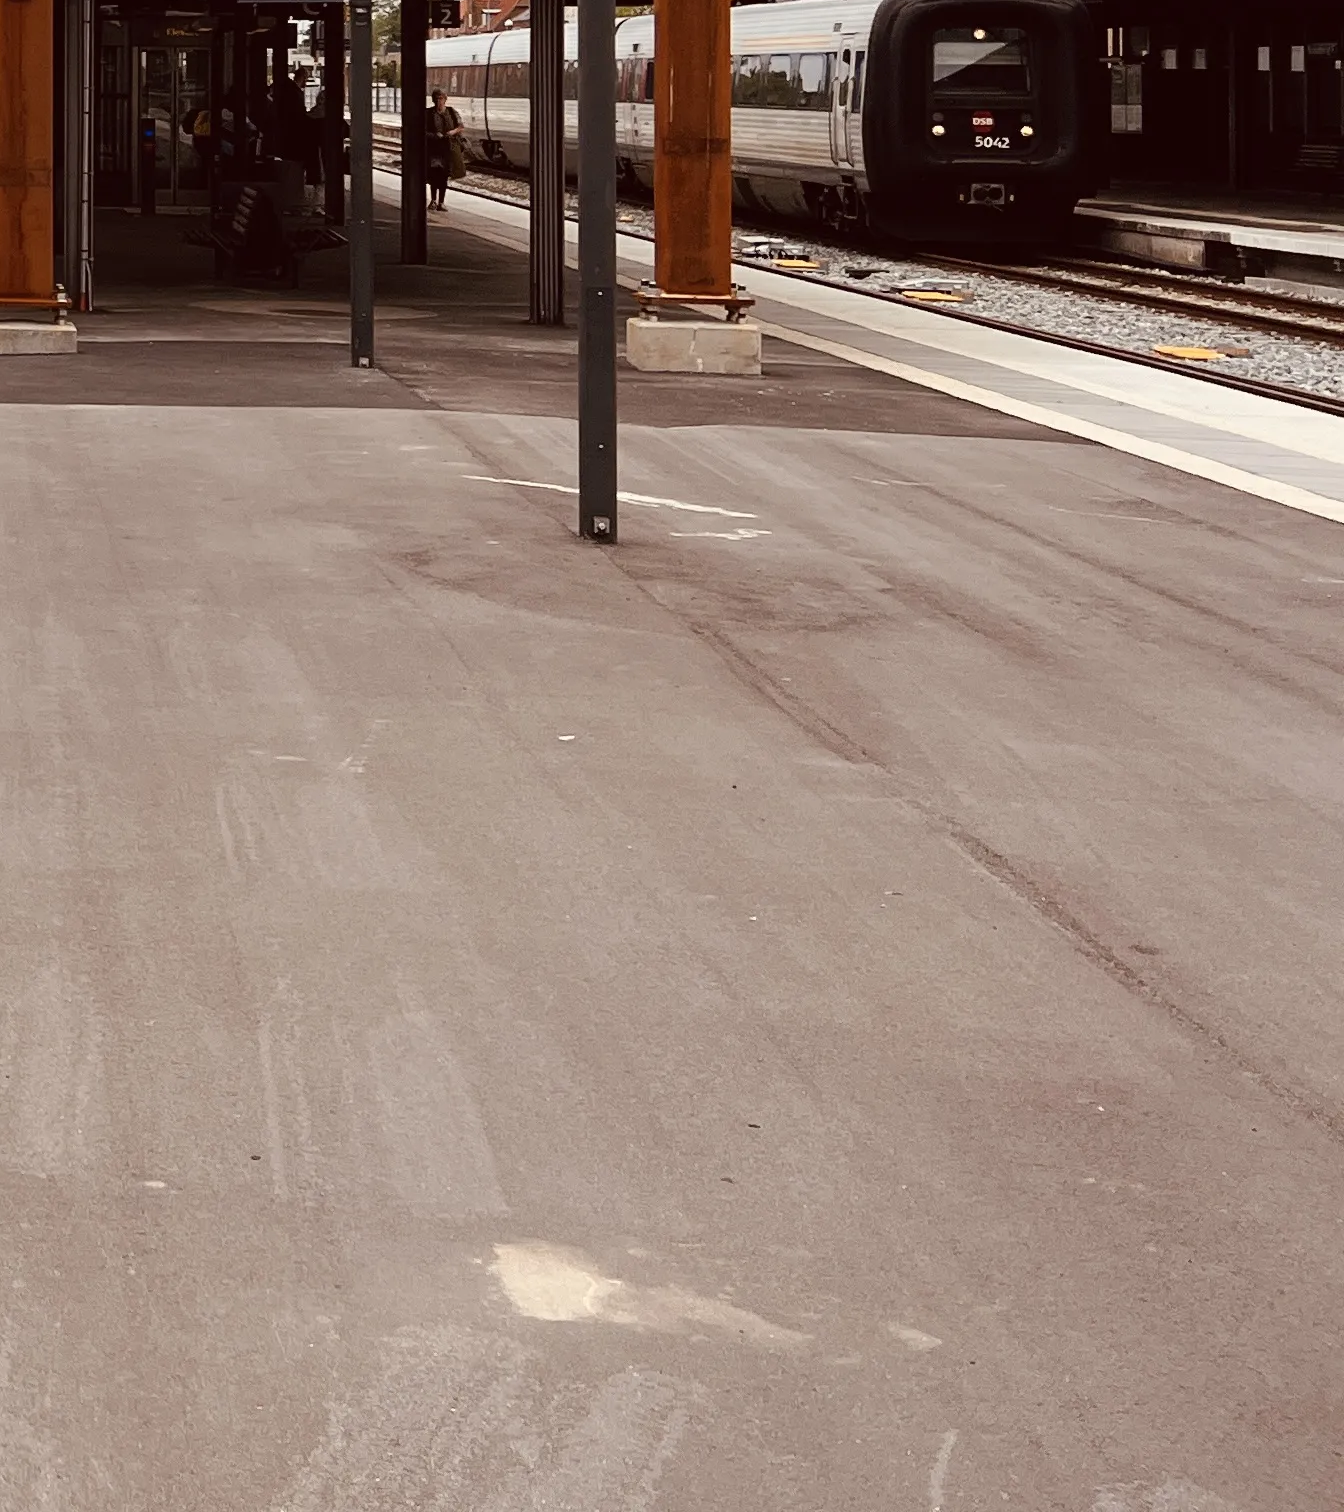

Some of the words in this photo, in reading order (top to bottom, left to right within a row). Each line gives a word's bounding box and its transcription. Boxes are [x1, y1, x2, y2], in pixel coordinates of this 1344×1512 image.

[441, 9, 452, 25] 2
[972, 117, 993, 126] DSB
[974, 135, 1010, 148] 5042
